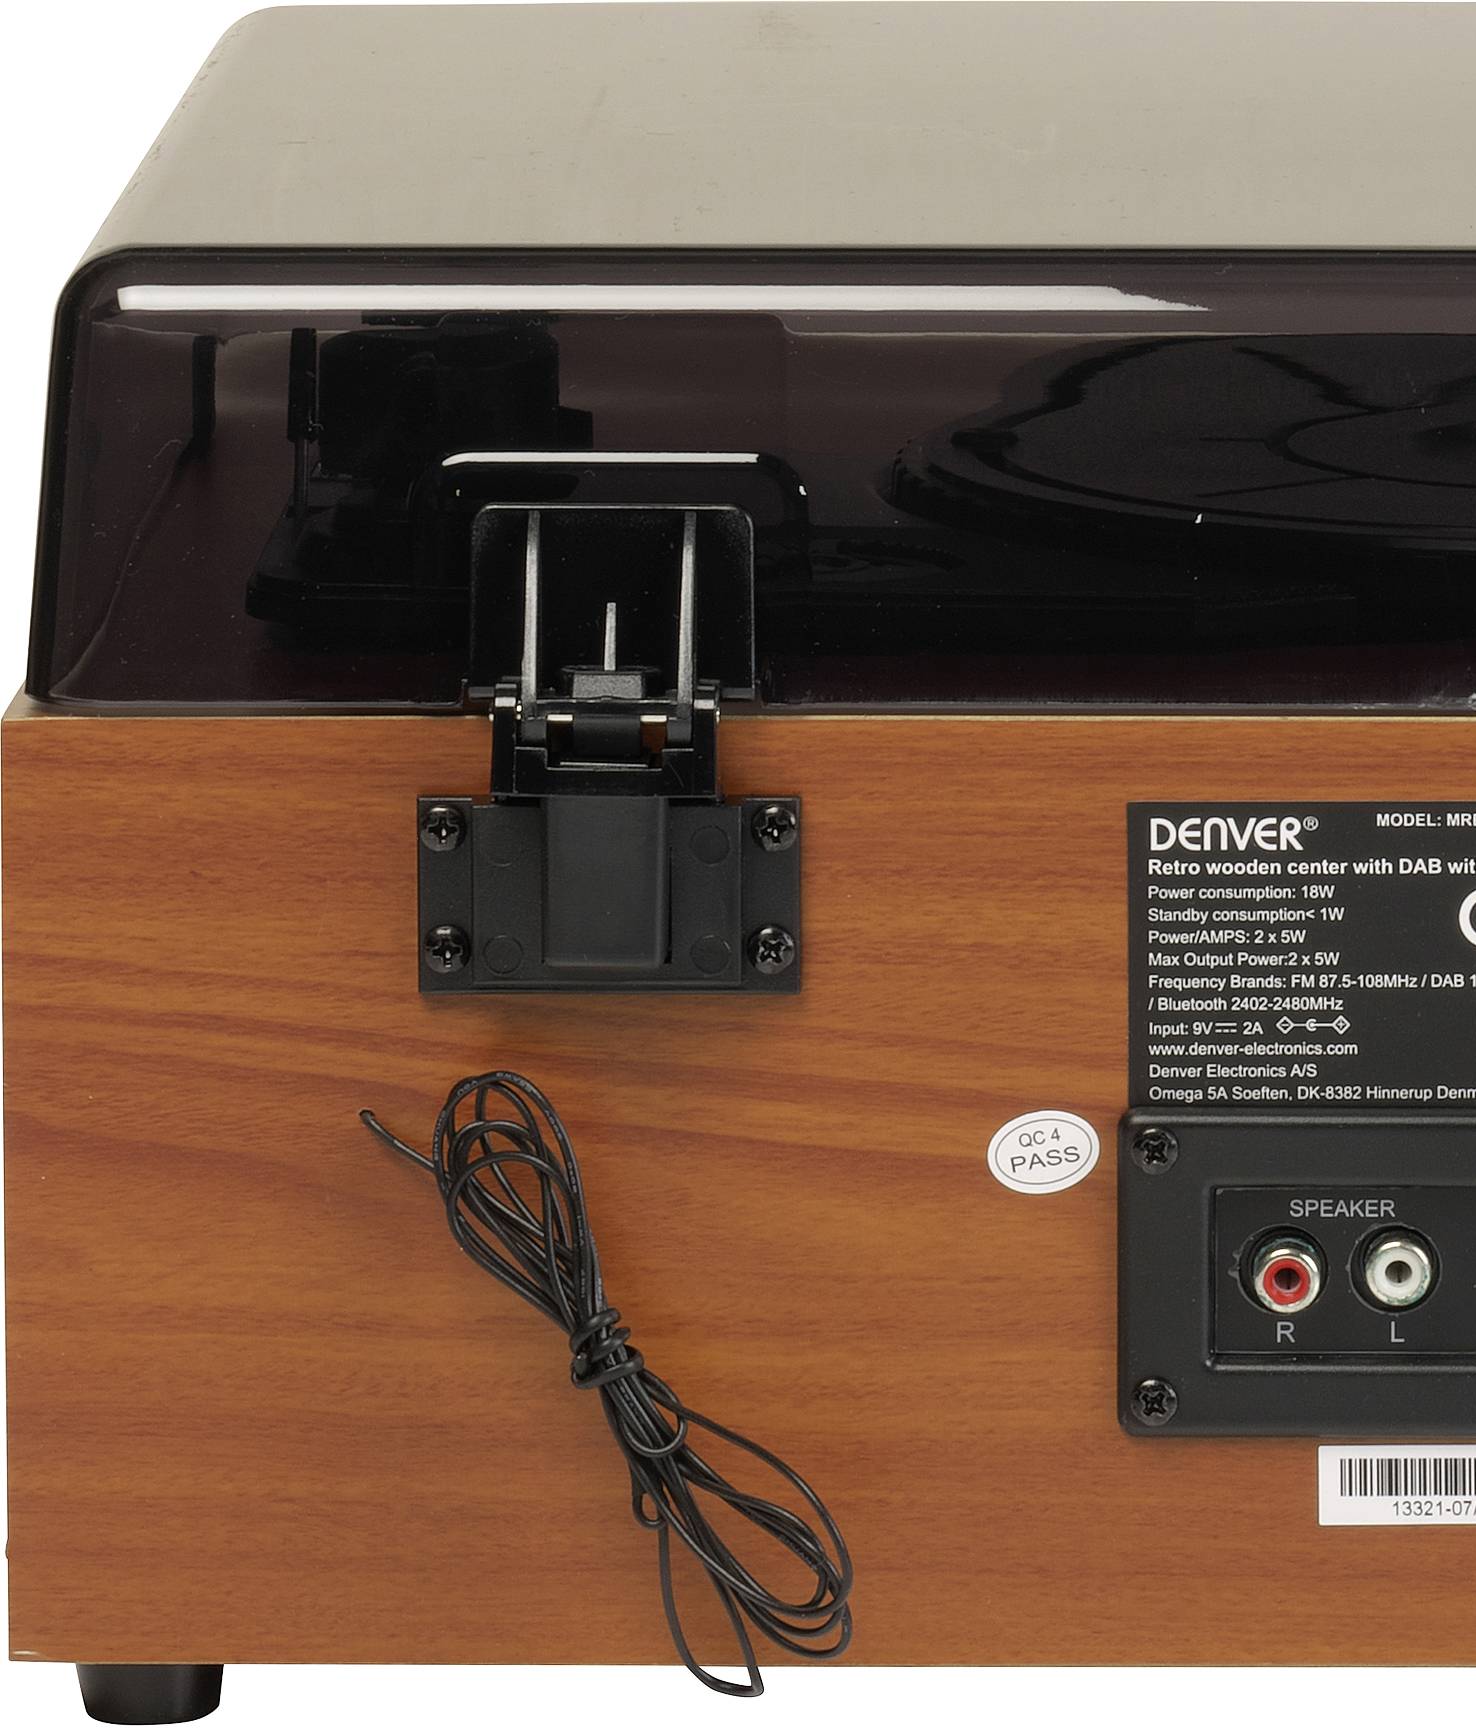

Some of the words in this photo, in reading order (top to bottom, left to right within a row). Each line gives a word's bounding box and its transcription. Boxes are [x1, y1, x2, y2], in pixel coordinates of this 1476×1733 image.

[1376, 812, 1442, 827] MODEL:
[1148, 858, 1201, 876] Retro
[1205, 858, 1282, 875] wooden
[1286, 858, 1349, 875] center
[1352, 857, 1394, 875] with
[1398, 857, 1443, 875] DAB
[1147, 885, 1196, 900] Power
[1198, 884, 1296, 902] consumption:
[1301, 884, 1336, 899] 18W
[1147, 907, 1209, 925] Standby
[1319, 906, 1345, 921] 1W
[1148, 929, 1251, 945] Power/AMPS:
[1254, 929, 1265, 944] 2
[1267, 932, 1278, 944] x
[1280, 929, 1307, 944] 5W
[1148, 952, 1180, 967] Max
[1183, 951, 1234, 970] Output
[1237, 951, 1298, 966] Power:2
[1301, 954, 1311, 966] x
[1314, 951, 1340, 966] 5W
[1148, 974, 1227, 992] Frequency
[1230, 974, 1287, 989] Brands:
[1290, 973, 1315, 989] FM
[1318, 973, 1418, 989] 87.5-108MHz
[1420, 973, 1428, 988] /
[1430, 973, 1465, 988] DAB
[1147, 996, 1155, 1011] /
[1157, 996, 1228, 1011] Bluetooth
[1230, 996, 1344, 1011] 2402-2480MHz
[1149, 1021, 1189, 1038] Input:
[1242, 1021, 1264, 1035] 2A
[1148, 1041, 1359, 1056] www.denver-electronics.com
[1149, 1063, 1203, 1078] Denver
[1206, 1063, 1287, 1078] Electronics
[1289, 1063, 1318, 1078] A/S
[1149, 1086, 1203, 1104] Omega
[1207, 1086, 1229, 1101] 5A
[1231, 1085, 1293, 1101] Soeften,
[1297, 1085, 1362, 1100] DK-8382
[1366, 1085, 1433, 1102] Hinnerup
[1017, 1129, 1047, 1149] QC
[1049, 1127, 1062, 1142] 4
[1009, 1145, 1081, 1174] PASS
[1289, 1199, 1396, 1218] SPEAKER
[1276, 1321, 1296, 1344] R
[1390, 1320, 1405, 1343] L
